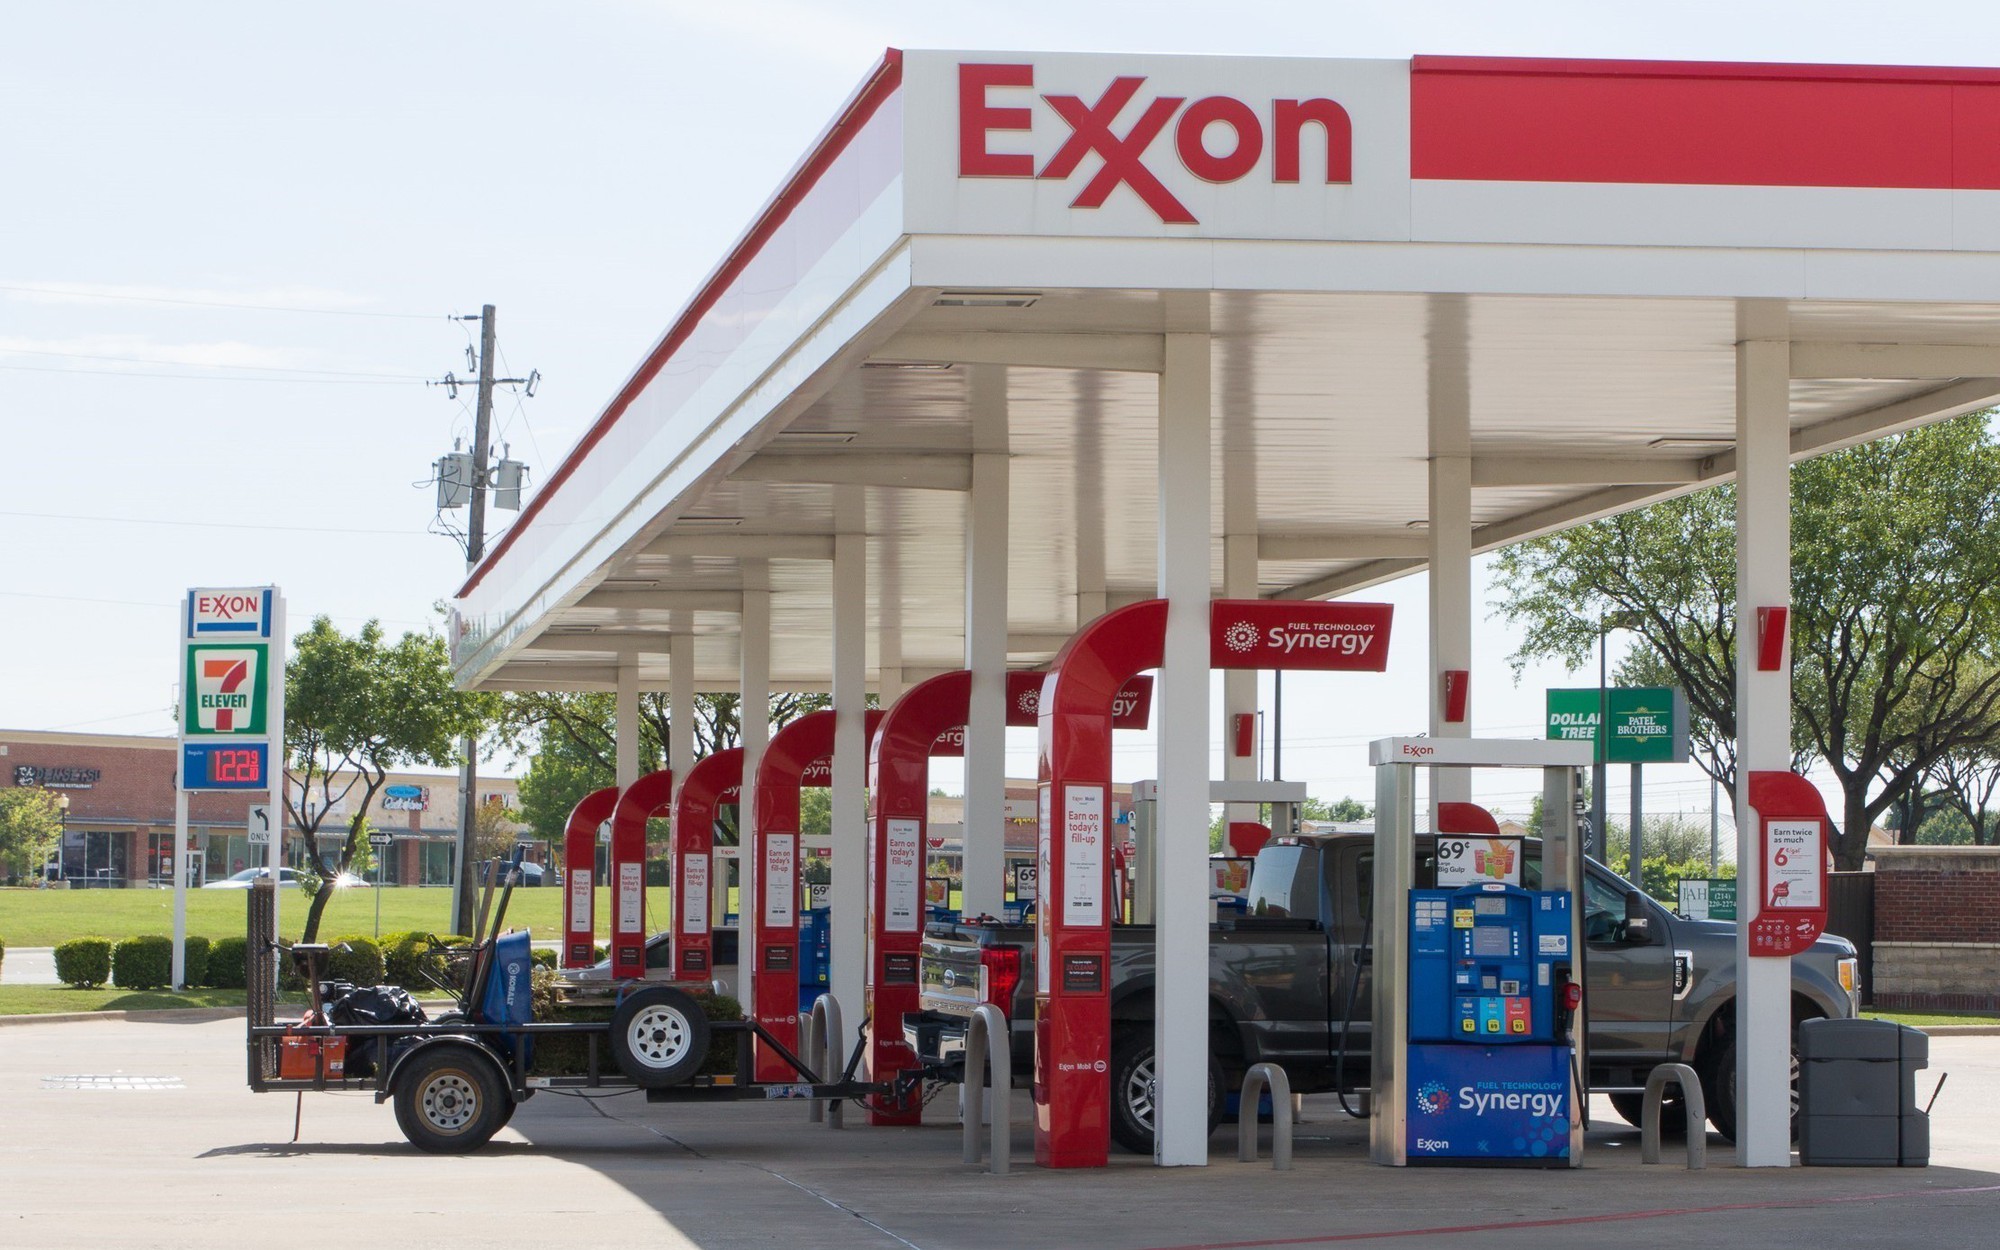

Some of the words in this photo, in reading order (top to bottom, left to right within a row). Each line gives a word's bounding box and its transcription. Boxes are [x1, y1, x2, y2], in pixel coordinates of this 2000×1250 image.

[958, 63, 1353, 225] Exxon
[199, 594, 258, 619] EXXON
[1313, 623, 1375, 631] TECHNOLOGY
[1268, 627, 1374, 654] Synergy
[204, 660, 247, 731] 7
[1628, 716, 1656, 725] PATEL
[1560, 727, 1596, 738] TREE
[1617, 725, 1667, 735] BROTHERS
[1403, 745, 1434, 757] Exxon
[1068, 811, 1087, 820] Earn
[1088, 813, 1098, 821] on
[1069, 823, 1098, 836] today's
[1773, 828, 1791, 836] Earn
[1792, 828, 1813, 836] twice
[251, 832, 270, 840] ONLY
[1071, 834, 1096, 845] fill-up
[889, 838, 905, 848] Earn
[890, 848, 915, 858] today's
[1774, 847, 1788, 867] 6
[892, 857, 913, 867] fill-up
[1449, 866, 1465, 874] Gulp
[1682, 888, 1708, 901] JAH
[1558, 896, 1565, 909] 1
[1059, 1063, 1075, 1071] Exxon
[1502, 1082, 1563, 1090] TECHNOLOGY
[1459, 1086, 1563, 1116] Synergy
[1417, 1139, 1449, 1151] Exxon
